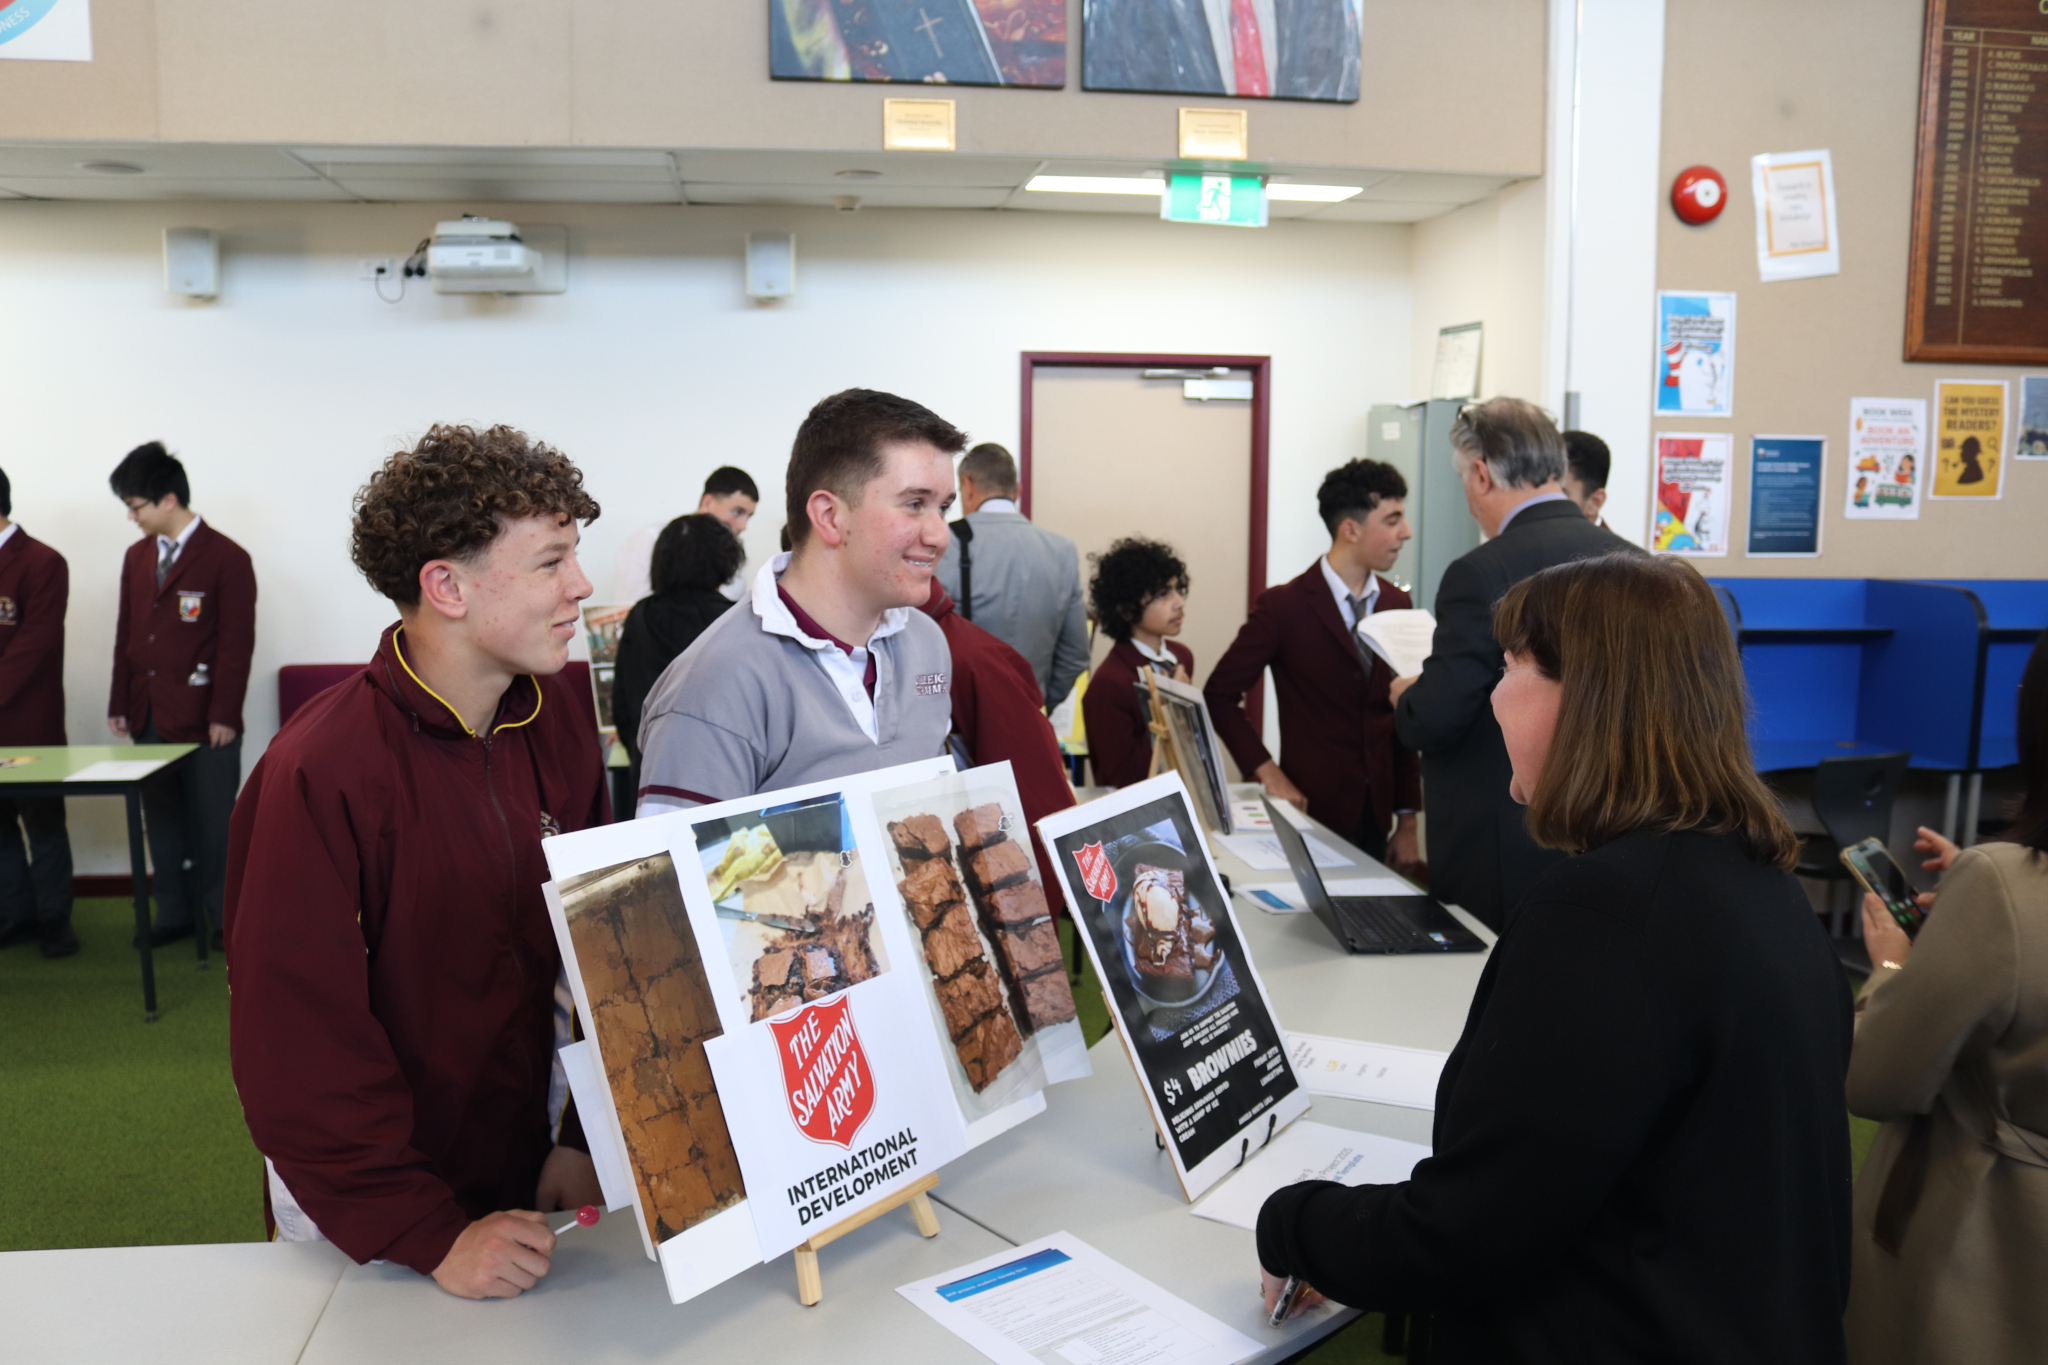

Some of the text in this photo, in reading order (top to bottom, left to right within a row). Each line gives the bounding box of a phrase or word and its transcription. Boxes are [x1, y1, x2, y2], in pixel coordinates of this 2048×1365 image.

[0, 6, 31, 34] NESS
[1946, 419, 1998, 430] READERS?
[1961, 408, 1999, 416] MYSTERY
[789, 1010, 821, 1070] THE
[1186, 1028, 1258, 1092] BROWNIES
[791, 1007, 855, 1127] SALVATION
[825, 1051, 862, 1138] ARMY
[1163, 1077, 1184, 1106] $4
[1171, 1080, 1231, 1126] DELICIOUS BROWNIES SERVED
[1174, 1098, 1220, 1135] WITH A SCOOP OF ICE
[1178, 1126, 1197, 1143] CREAM
[787, 1127, 918, 1206] INTERNATIONAL
[1336, 1154, 1365, 1176] Template
[797, 1147, 919, 1226] DEVELOPMENT
